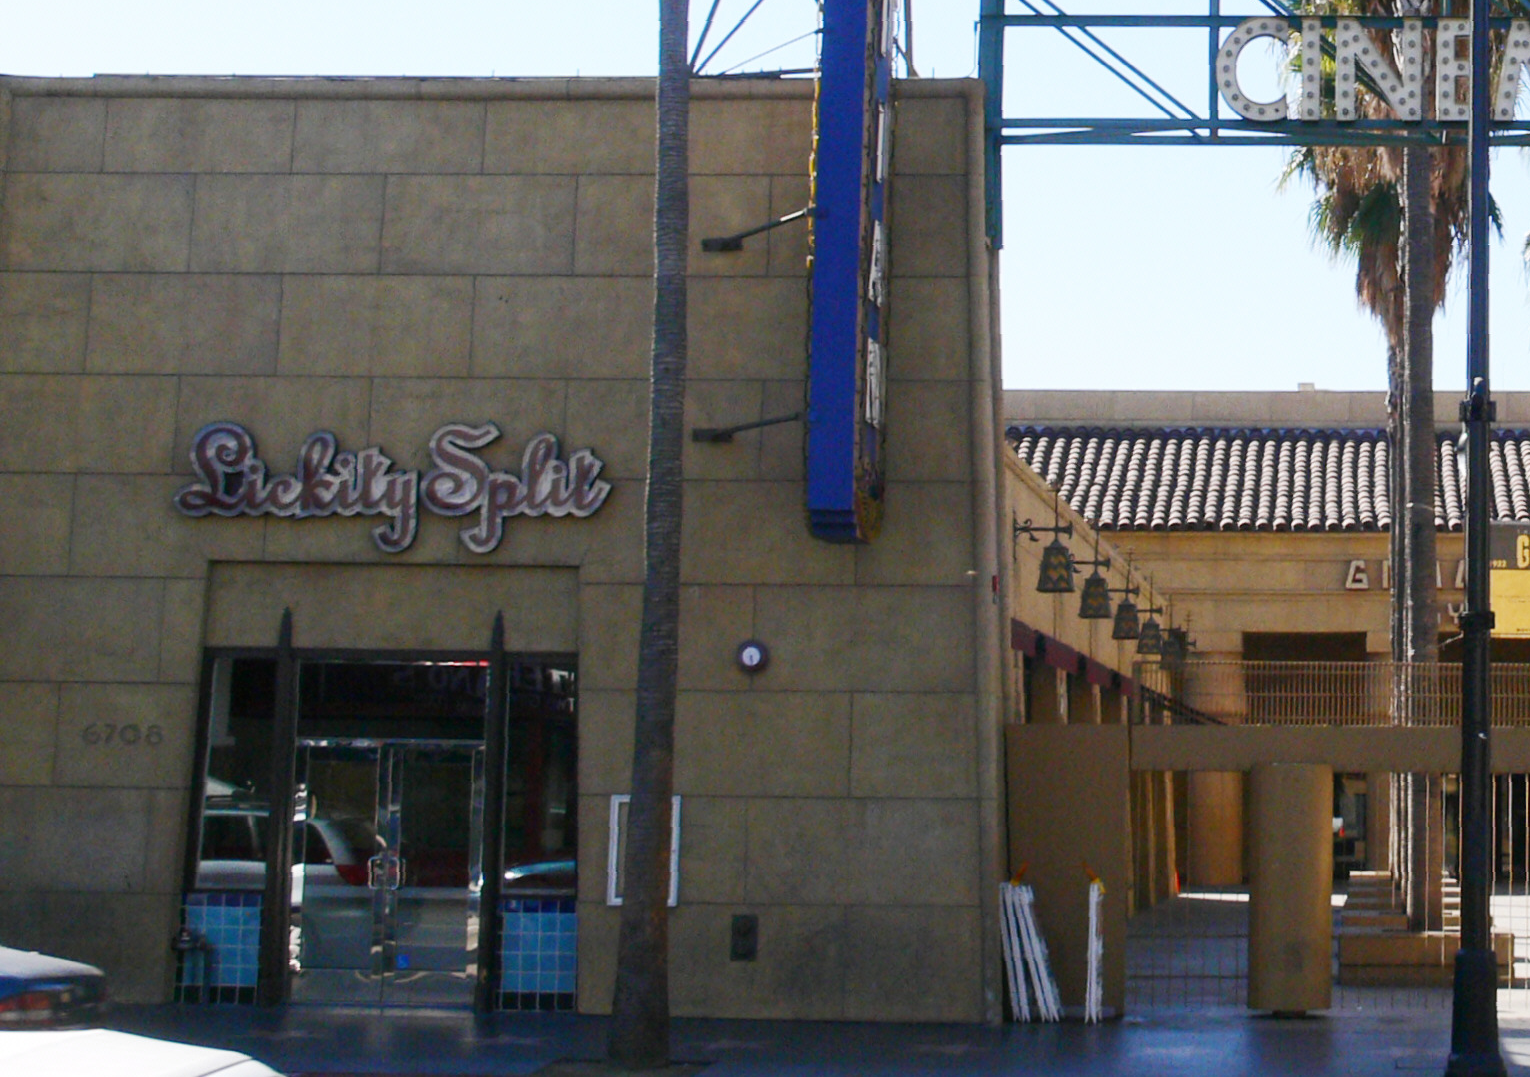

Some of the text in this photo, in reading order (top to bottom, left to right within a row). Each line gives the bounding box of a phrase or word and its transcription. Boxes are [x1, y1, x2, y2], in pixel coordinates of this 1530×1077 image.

[174, 420, 613, 553] Lickity Split
[82, 723, 163, 745] 6708
